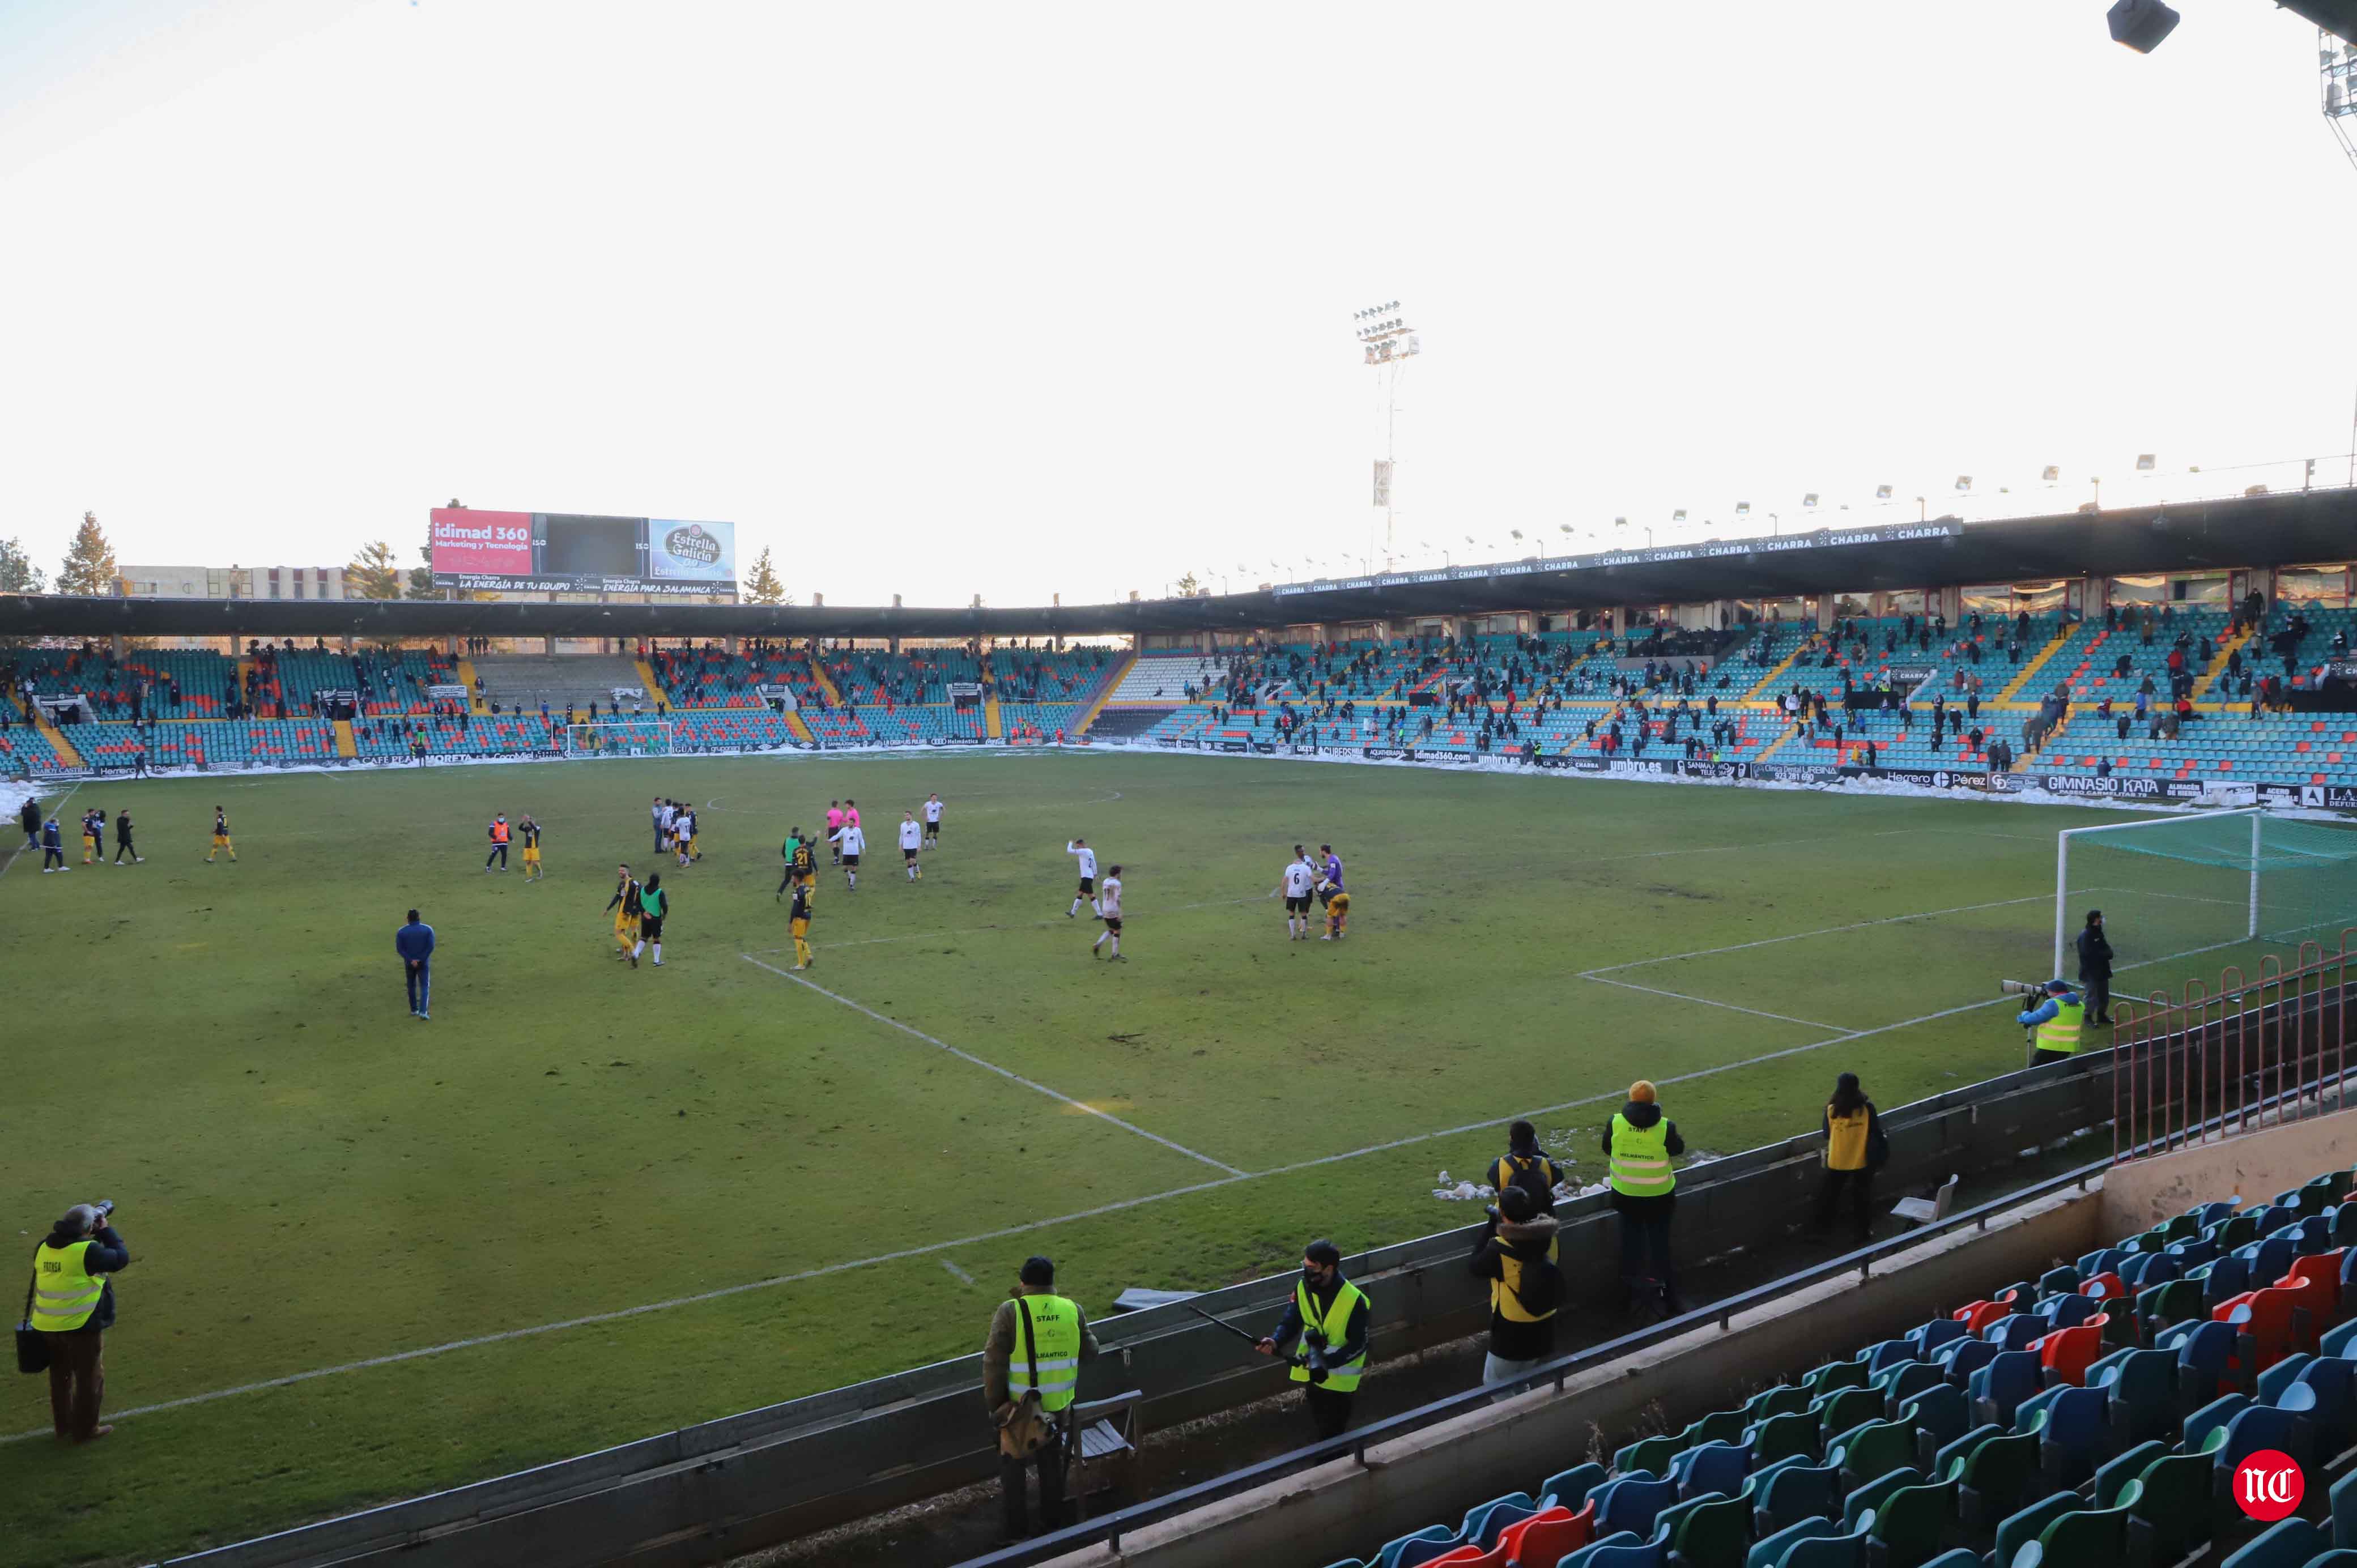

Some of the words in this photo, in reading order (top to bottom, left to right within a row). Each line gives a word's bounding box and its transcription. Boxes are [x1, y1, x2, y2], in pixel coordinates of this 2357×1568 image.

[435, 522, 492, 540] idimad
[496, 527, 528, 541] 360
[1898, 526, 1950, 539] CHARRA
[672, 532, 717, 551] Estrella
[1767, 539, 1812, 550] CHARRA
[1830, 533, 1878, 545] CHARRA
[435, 540, 477, 549] Marketing
[486, 542, 529, 551] Tecnología
[1708, 545, 1750, 555] CHARRA
[673, 544, 712, 562] Galicia
[1654, 551, 1693, 561] CHARRA
[1545, 561, 1578, 570] CHARRA
[1603, 556, 1640, 565] CHARRA
[1458, 569, 1488, 578] CHARRA
[1500, 565, 1532, 575] CHARRA
[1382, 577, 1409, 585] CHARRA
[1419, 573, 1448, 582] CHARRA
[473, 579, 512, 589] ENERGÍA
[513, 581, 525, 589] DE
[526, 581, 538, 590] TU
[539, 582, 571, 591] EQUIPO
[603, 582, 639, 593] ENERGÍA
[640, 583, 661, 593] PARA
[662, 584, 710, 594] SALAMANCA
[1346, 580, 1372, 589] CHARRA
[1414, 750, 1470, 761] idimad360.com
[1478, 754, 1521, 765] umbro.es
[1610, 758, 1662, 772] umbro.es
[1802, 766, 1837, 775] URBINA
[1887, 772, 1931, 783] Herrero
[1952, 774, 1986, 786] Pérez
[2048, 777, 2118, 791] GIMNASIO
[2123, 779, 2159, 793] KATA
[797, 852, 808, 866] 21
[1294, 872, 1300, 885] 6
